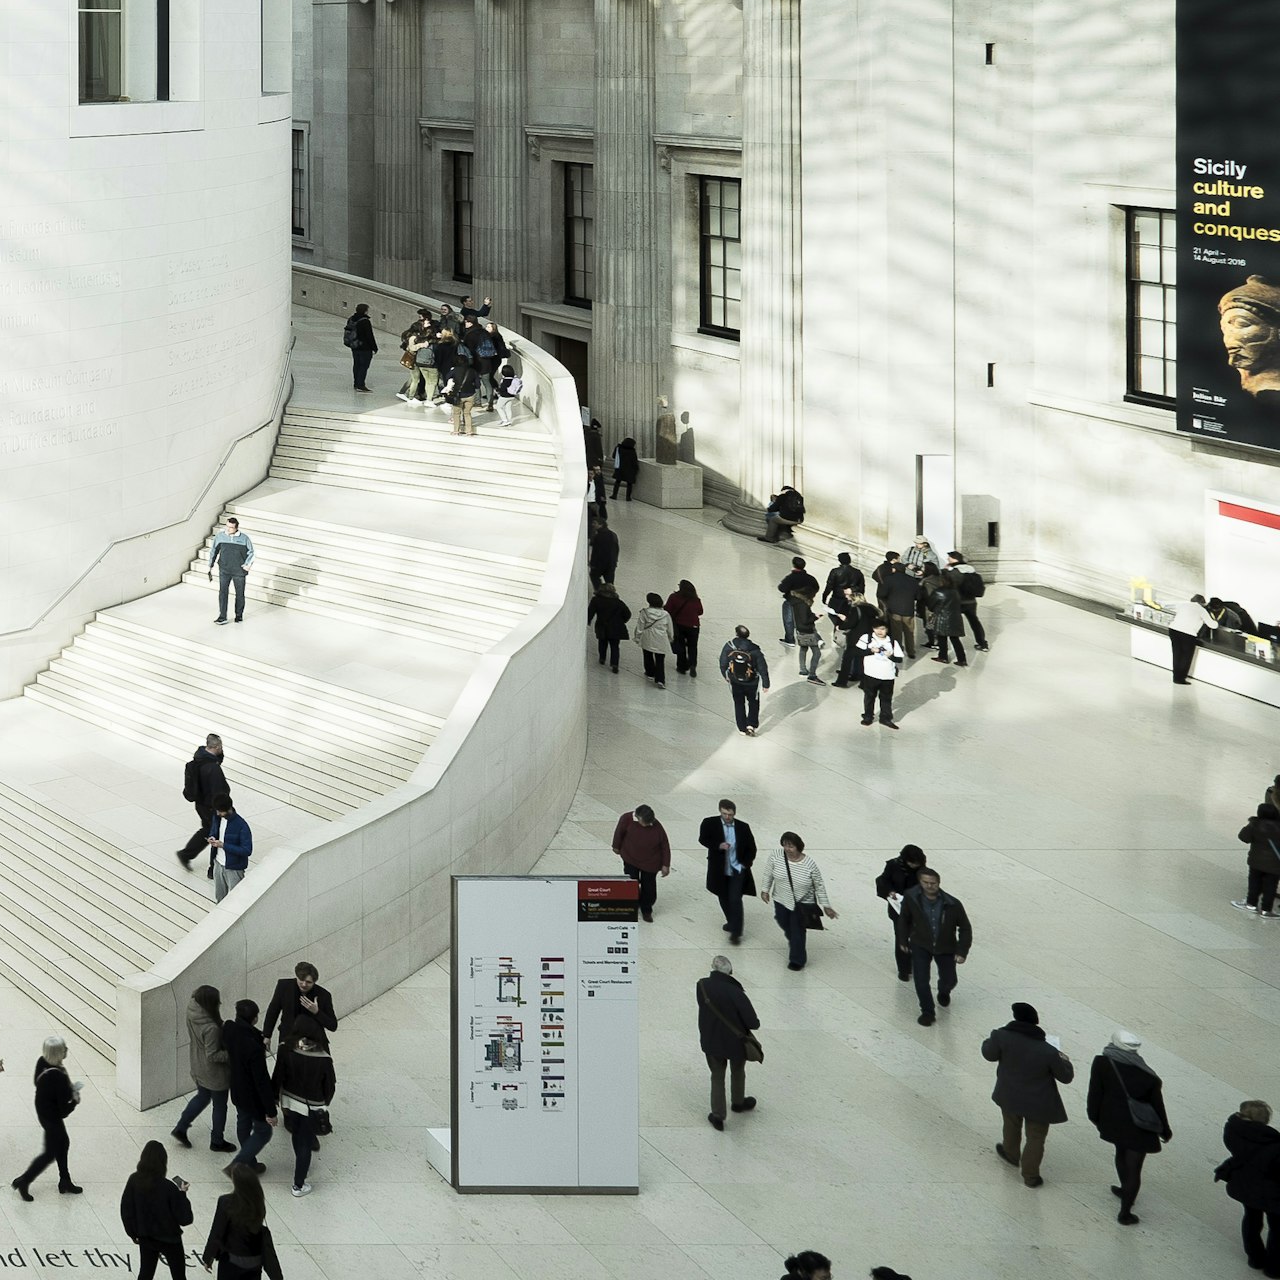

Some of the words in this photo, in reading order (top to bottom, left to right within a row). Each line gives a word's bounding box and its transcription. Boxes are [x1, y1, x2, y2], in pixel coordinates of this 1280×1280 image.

[1193, 157, 1247, 180] Sicily
[1193, 179, 1265, 199] culture
[1193, 201, 1231, 217] and
[1202, 255, 1227, 265] August
[1203, 248, 1219, 257] April
[32, 1248, 78, 1268] let
[82, 1248, 132, 1272] thy
